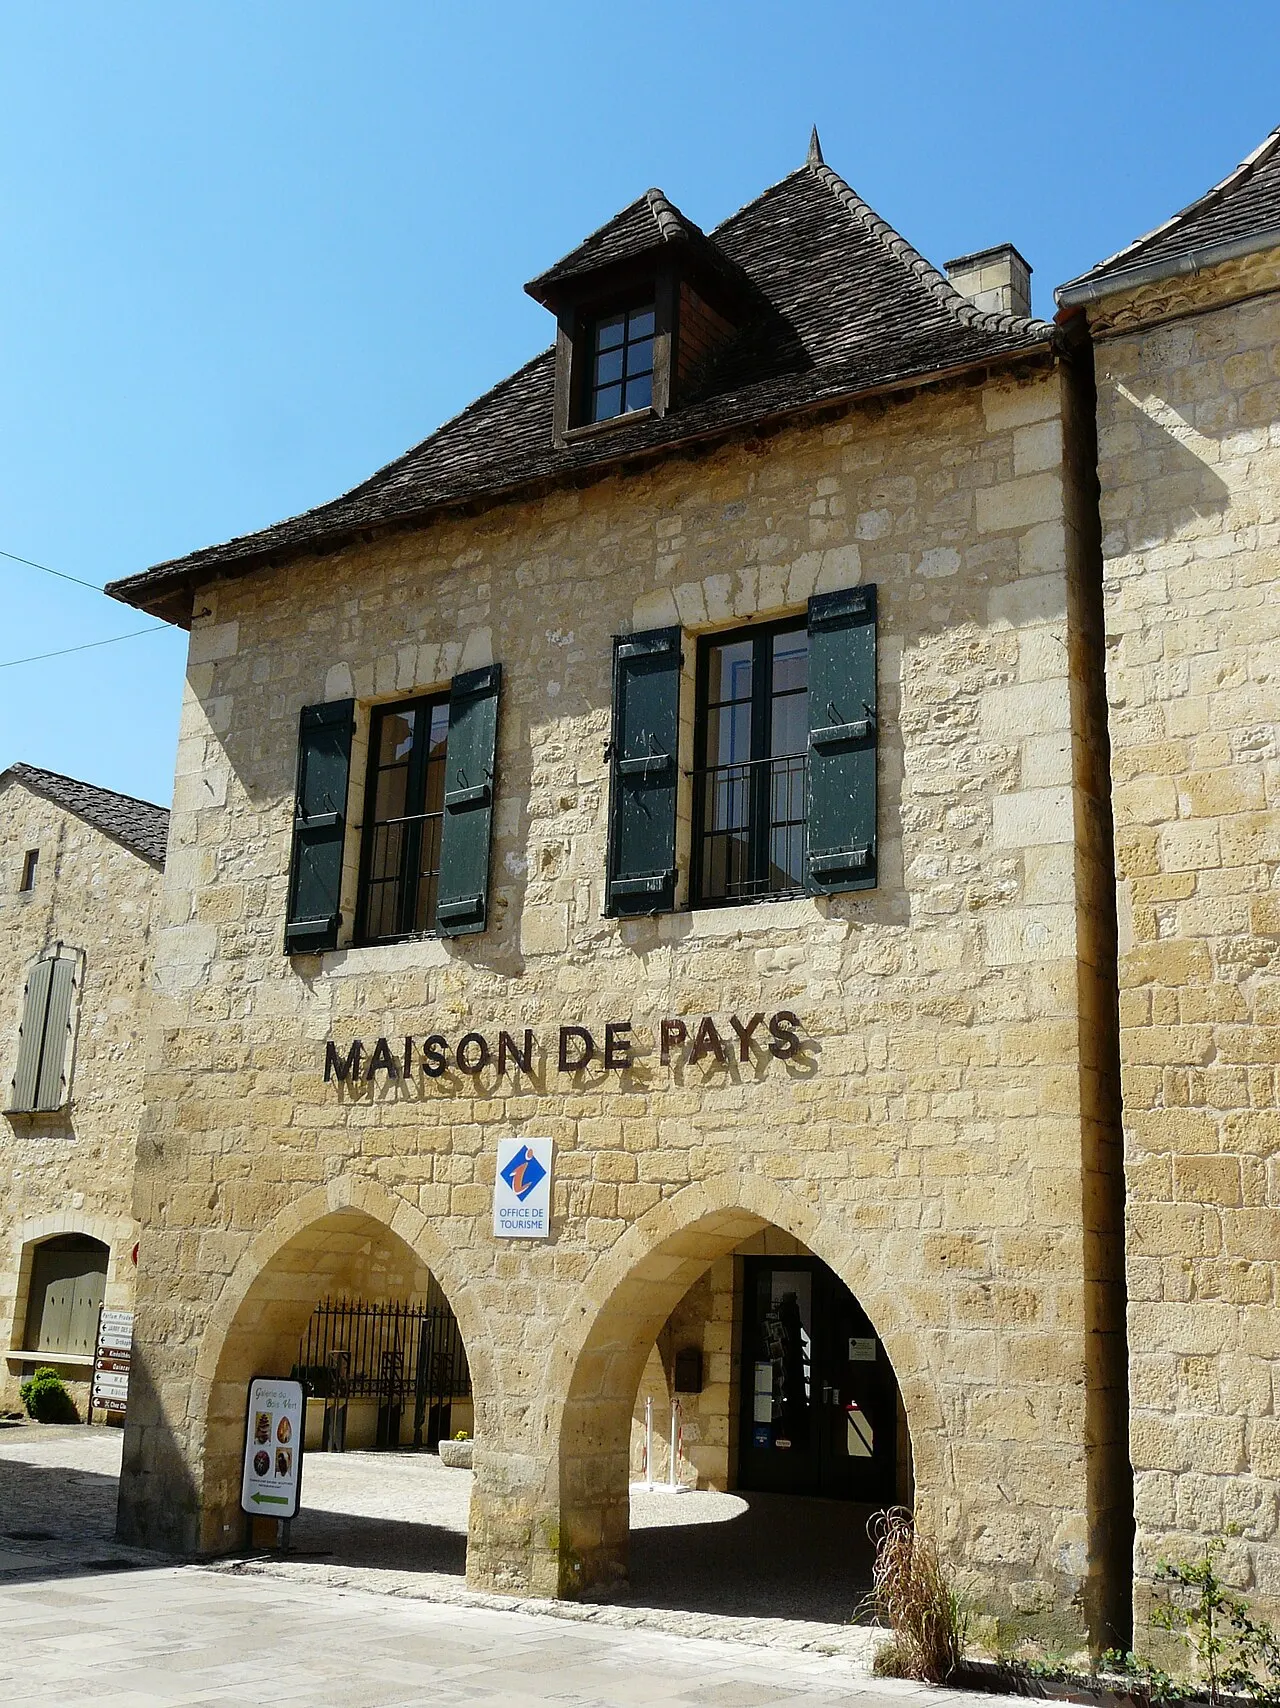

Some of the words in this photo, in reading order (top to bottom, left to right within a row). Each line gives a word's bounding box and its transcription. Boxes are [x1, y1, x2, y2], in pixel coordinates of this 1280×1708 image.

[324, 1028, 534, 1082] MAISON
[558, 1022, 632, 1072] DE
[660, 1011, 802, 1067] PAYS
[499, 1208, 530, 1218] OFFICE
[531, 1208, 544, 1218] DE
[500, 1219, 543, 1229] TOURISME
[255, 1387, 278, 1400] Galerie
[266, 1398, 280, 1409] Bois
[283, 1399, 297, 1410] Vert
